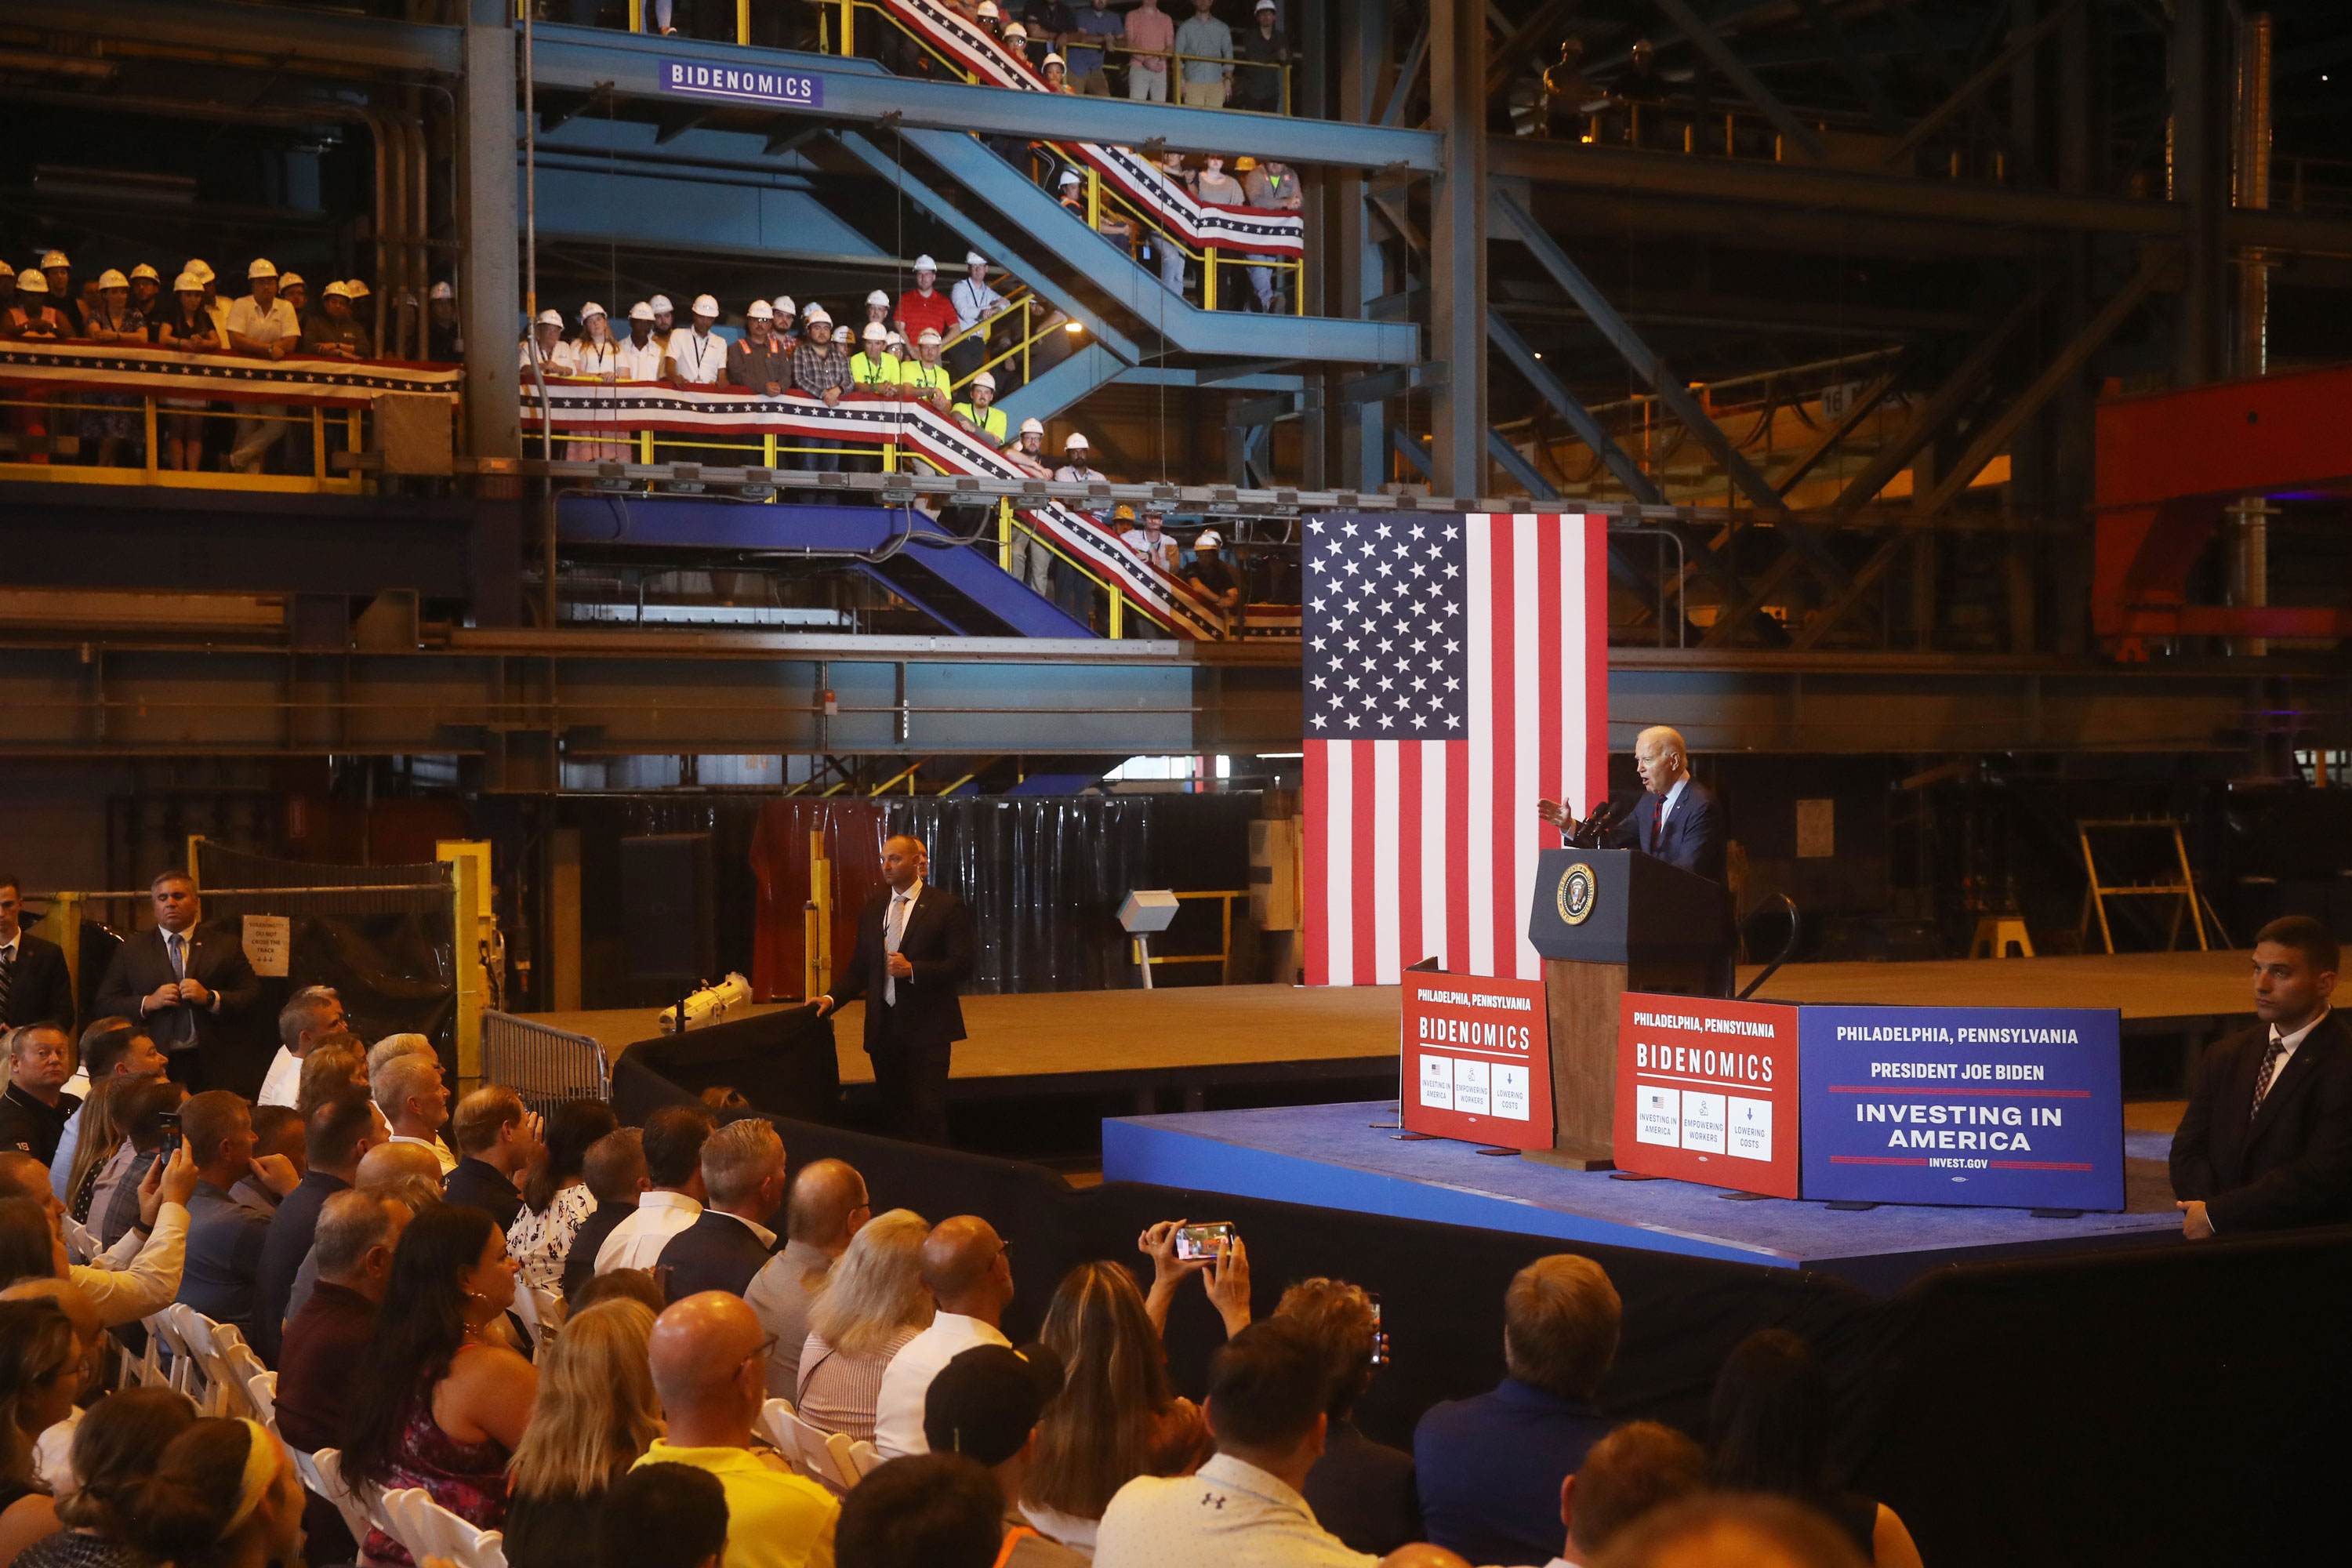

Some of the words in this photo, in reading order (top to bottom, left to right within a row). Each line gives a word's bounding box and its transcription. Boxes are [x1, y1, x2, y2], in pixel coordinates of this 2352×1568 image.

[672, 64, 811, 97] BIDENOMICS
[1417, 989, 1471, 1007] PHILADELPHIA,
[1472, 993, 1531, 1011] PENNSYLVANIA
[1634, 1011, 1703, 1033] PHILADELPHIA,
[1704, 1018, 1775, 1038] PENNSYLVANIA
[1419, 1016, 1530, 1051] BIDENOMICS
[1837, 1026, 1954, 1045] PHILADELPHIA,
[1958, 1028, 2078, 1044] PENNSYLVANIA
[1636, 1043, 1773, 1082] BIDENOMICS
[1871, 1062, 1958, 1079] PRESIDENT
[1961, 1064, 1991, 1080] JOE
[1995, 1065, 2045, 1080] BIDEN
[1422, 1080, 1445, 1089] INVESTING
[1456, 1084, 1488, 1094] EMPOWERING
[1426, 1091, 1446, 1099] AMERICA
[1461, 1095, 1483, 1105] WORKERS
[1497, 1090, 1523, 1100] LOWERING
[1501, 1101, 1518, 1109] COSTS
[1639, 1113, 1670, 1124] INVESTING
[1857, 1104, 2022, 1126] INVESTING
[2031, 1107, 2062, 1127] IN
[1645, 1125, 1671, 1136] AMERICA
[1684, 1119, 1723, 1132] EMPOWERING
[1690, 1131, 1718, 1142] WORKERS
[1734, 1126, 1765, 1138] LOWERING
[1740, 1138, 1759, 1149] COSTS
[1888, 1129, 2031, 1151] AMERICA
[1929, 1157, 1988, 1170] INVEST.GOV
